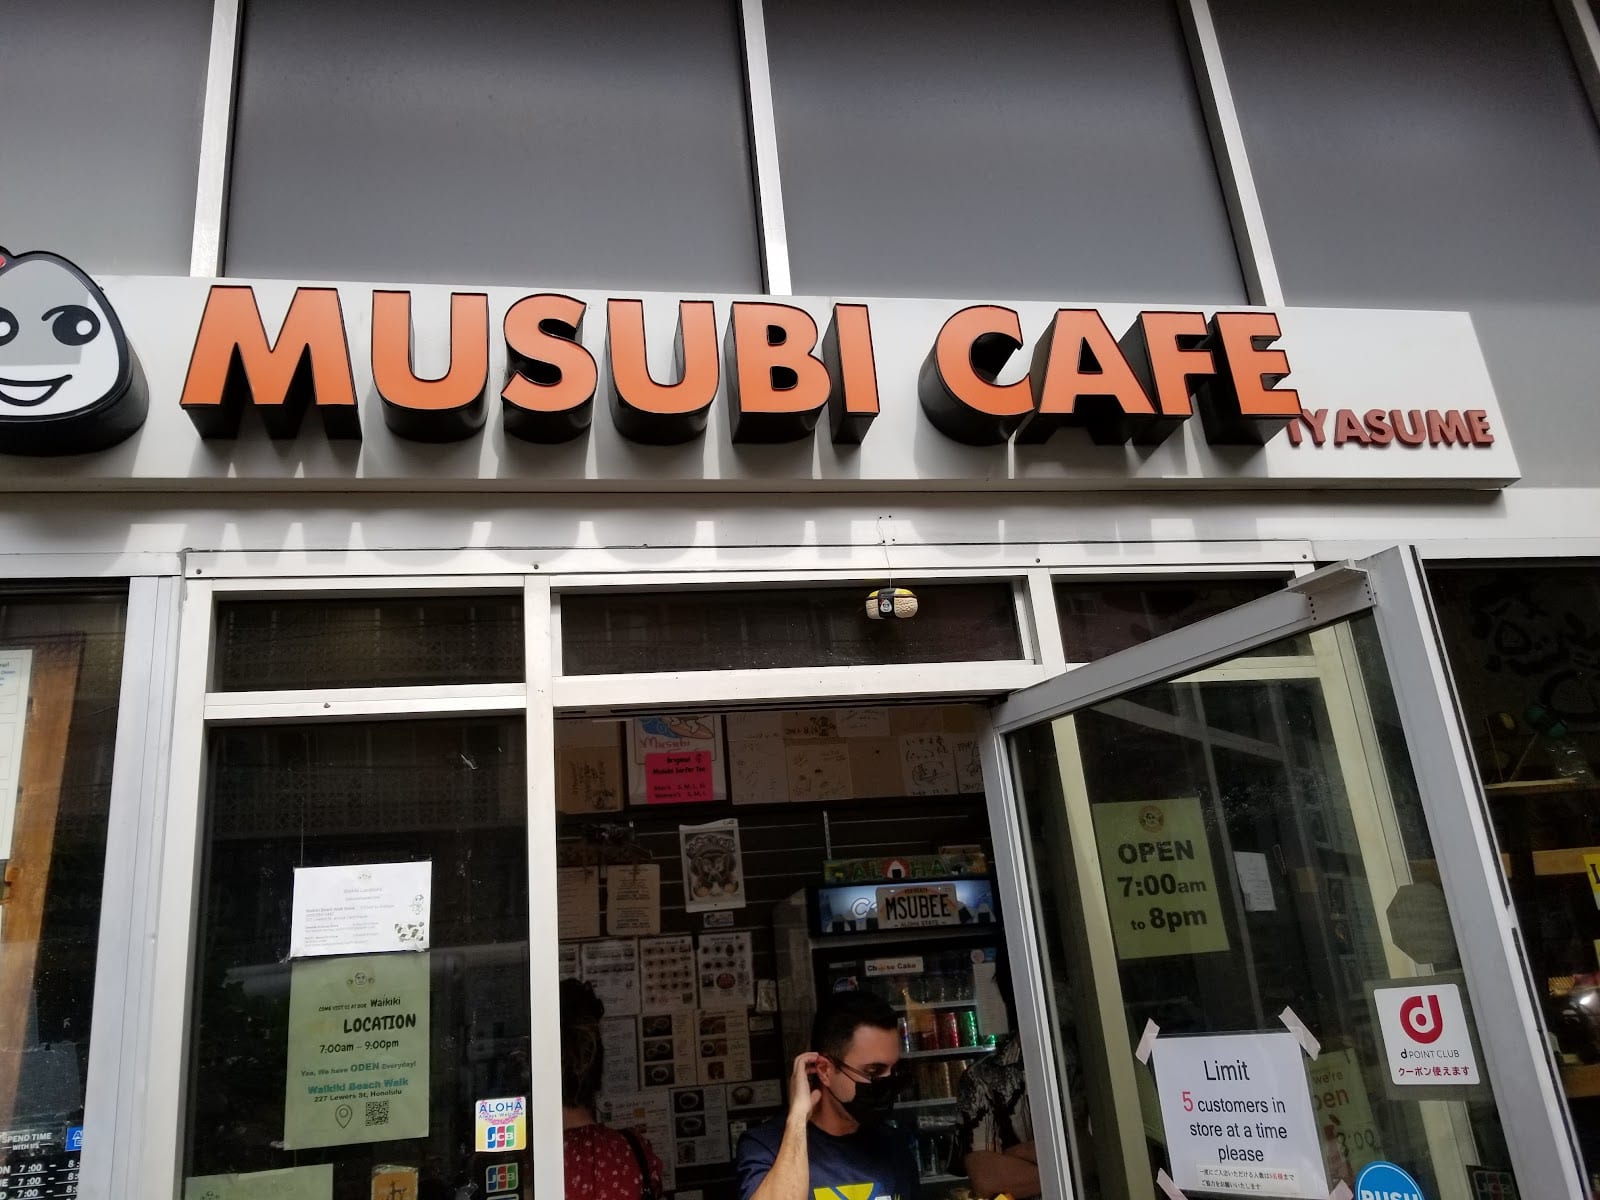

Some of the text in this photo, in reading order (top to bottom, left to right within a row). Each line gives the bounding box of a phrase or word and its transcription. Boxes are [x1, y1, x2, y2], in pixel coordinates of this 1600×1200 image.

[181, 284, 1301, 446] MUSUBI CAFE
[1118, 839, 1195, 865] OPEN
[1117, 873, 1208, 898] 7:00am
[885, 894, 951, 920] MSUBEE
[1130, 907, 1208, 933] to 8pm
[370, 997, 401, 1008] Waikiki
[343, 1013, 416, 1034] LOCATION
[320, 1043, 354, 1054] 7:00am
[365, 1039, 399, 1051] 9:00pm
[1409, 1050, 1436, 1059] POINT
[1437, 1049, 1460, 1059] CLUB
[350, 1062, 379, 1073] ODEN
[1203, 1059, 1250, 1081] Limit
[1398, 1066, 1470, 1077] クーポン使えます
[308, 1078, 409, 1095] Waikiki Beach Walk
[479, 1101, 523, 1113] ALOHA
[1182, 1091, 1286, 1114] 5 customers in
[32, 1132, 53, 1141] TIME
[1189, 1122, 1288, 1139] store at a time
[1218, 1145, 1264, 1163] please
